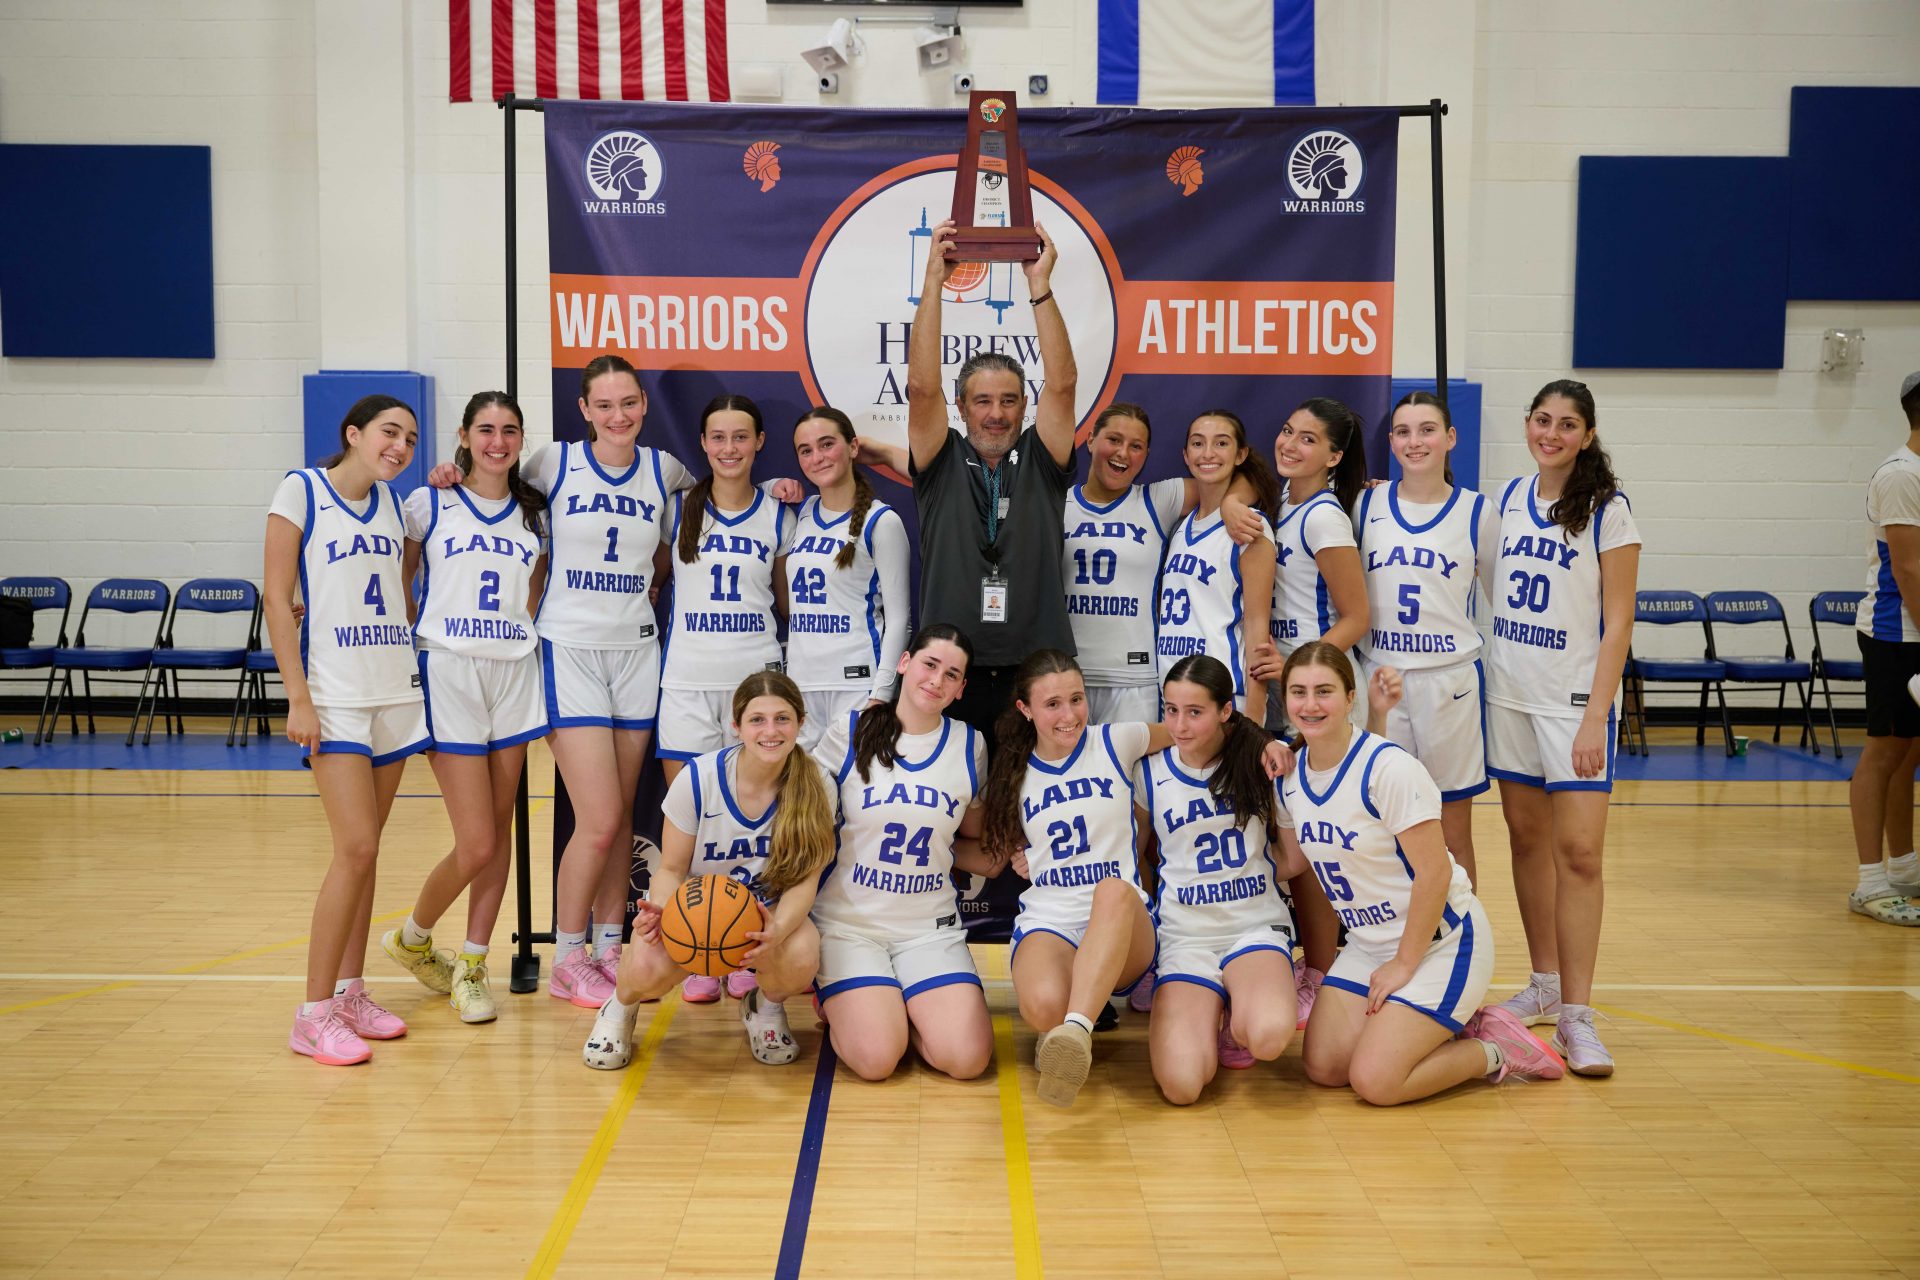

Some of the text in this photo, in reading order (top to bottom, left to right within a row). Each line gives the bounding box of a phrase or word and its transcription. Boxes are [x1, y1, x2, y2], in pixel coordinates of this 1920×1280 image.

[584, 201, 666, 215] WARRIORS
[1283, 200, 1364, 212] WARRIORS
[556, 292, 788, 351] WARRIORS
[1137, 299, 1377, 355] ATHLETICS
[876, 321, 1041, 365] HBREW
[566, 493, 656, 523] LADY
[326, 534, 402, 565] LADY
[444, 534, 534, 566] LADY
[604, 527, 619, 562] 1
[696, 534, 770, 564] ADY
[1502, 535, 1579, 570] LADY
[1074, 548, 1118, 585] 10
[1162, 554, 1217, 586] ADY
[1368, 546, 1458, 579] LADY
[2, 586, 56, 598] WARRIORS
[102, 588, 156, 600] WARRIORS
[190, 588, 244, 600] WARRIORS
[364, 574, 386, 616] 4
[478, 570, 500, 612] 2
[566, 570, 645, 594] WARRIORS
[710, 564, 742, 602] 11
[792, 567, 827, 604] 42
[1507, 570, 1550, 614] 30
[1064, 594, 1138, 617] ARRIORS
[1160, 588, 1191, 626] 33
[1398, 584, 1420, 625] 5
[1638, 600, 1694, 612] WARRIORS
[1714, 600, 1768, 612] WARRIORS
[1826, 601, 1860, 613] WARR
[334, 625, 411, 648] WARRIORS
[444, 618, 528, 640] WARRIORS
[684, 612, 766, 632] WARRIORS
[790, 613, 850, 634] ARRIORS
[1493, 616, 1568, 650] WARRIORS
[1158, 636, 1206, 656] RRIORS
[1371, 628, 1456, 653] WARRIORS
[862, 783, 960, 819] LADY
[1023, 777, 1114, 824] LADY
[1163, 797, 1236, 834] LAD
[703, 836, 772, 861] LAD
[878, 822, 934, 866] 24
[1047, 815, 1090, 860] 21
[1194, 828, 1248, 874] 20
[1297, 820, 1359, 852] ADY
[852, 862, 943, 894] WARRIORS
[1034, 861, 1121, 888] WARRIORS
[1177, 874, 1266, 906] WARRIORS
[1314, 861, 1354, 902] 15
[1334, 901, 1397, 928] RIORS
